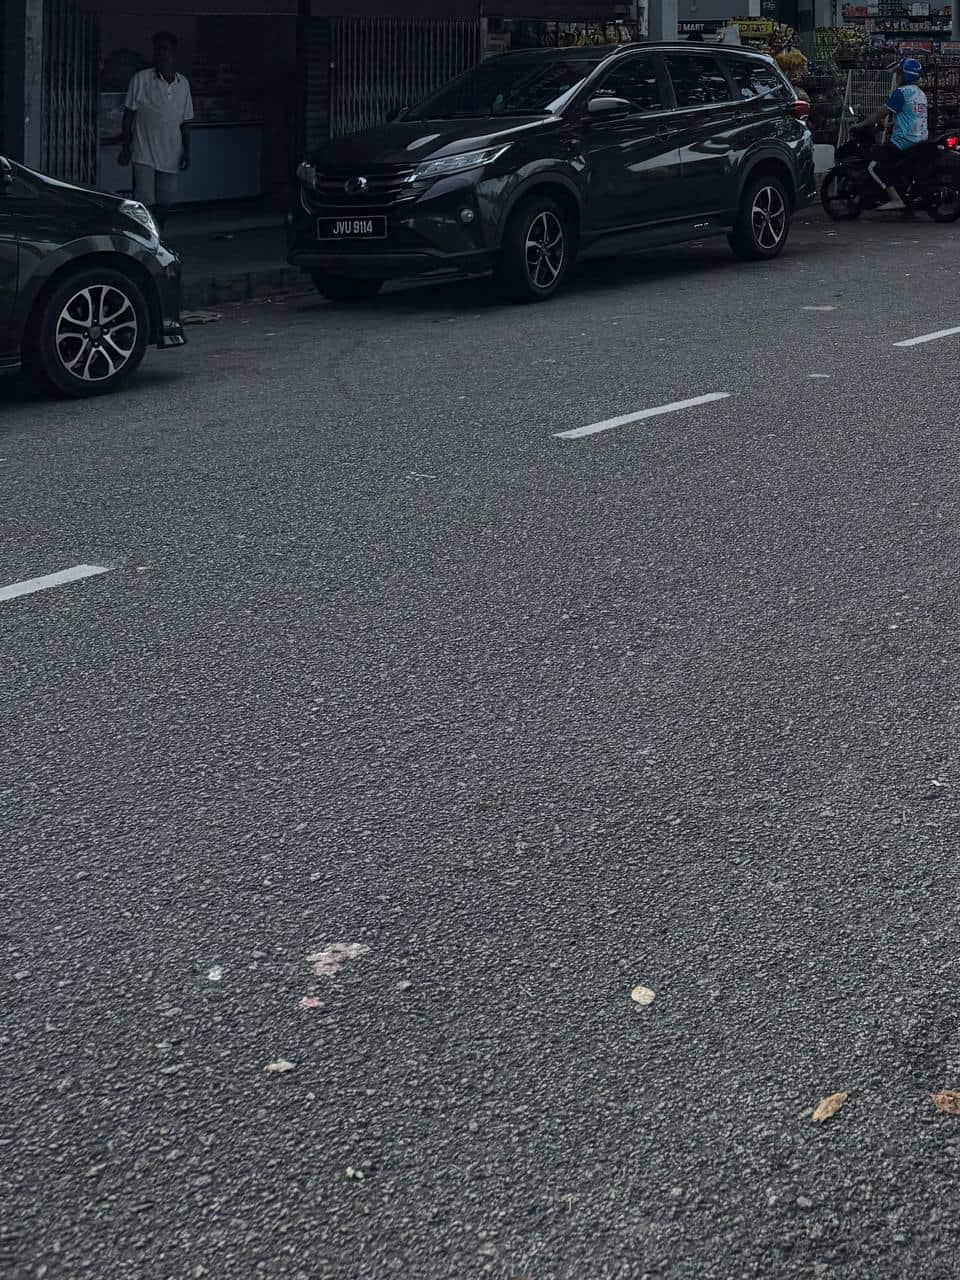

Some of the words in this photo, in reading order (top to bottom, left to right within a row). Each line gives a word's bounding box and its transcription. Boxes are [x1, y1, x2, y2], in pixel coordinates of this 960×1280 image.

[683, 23, 705, 32] MART
[333, 220, 351, 234] JVU
[353, 220, 373, 233] 9114
